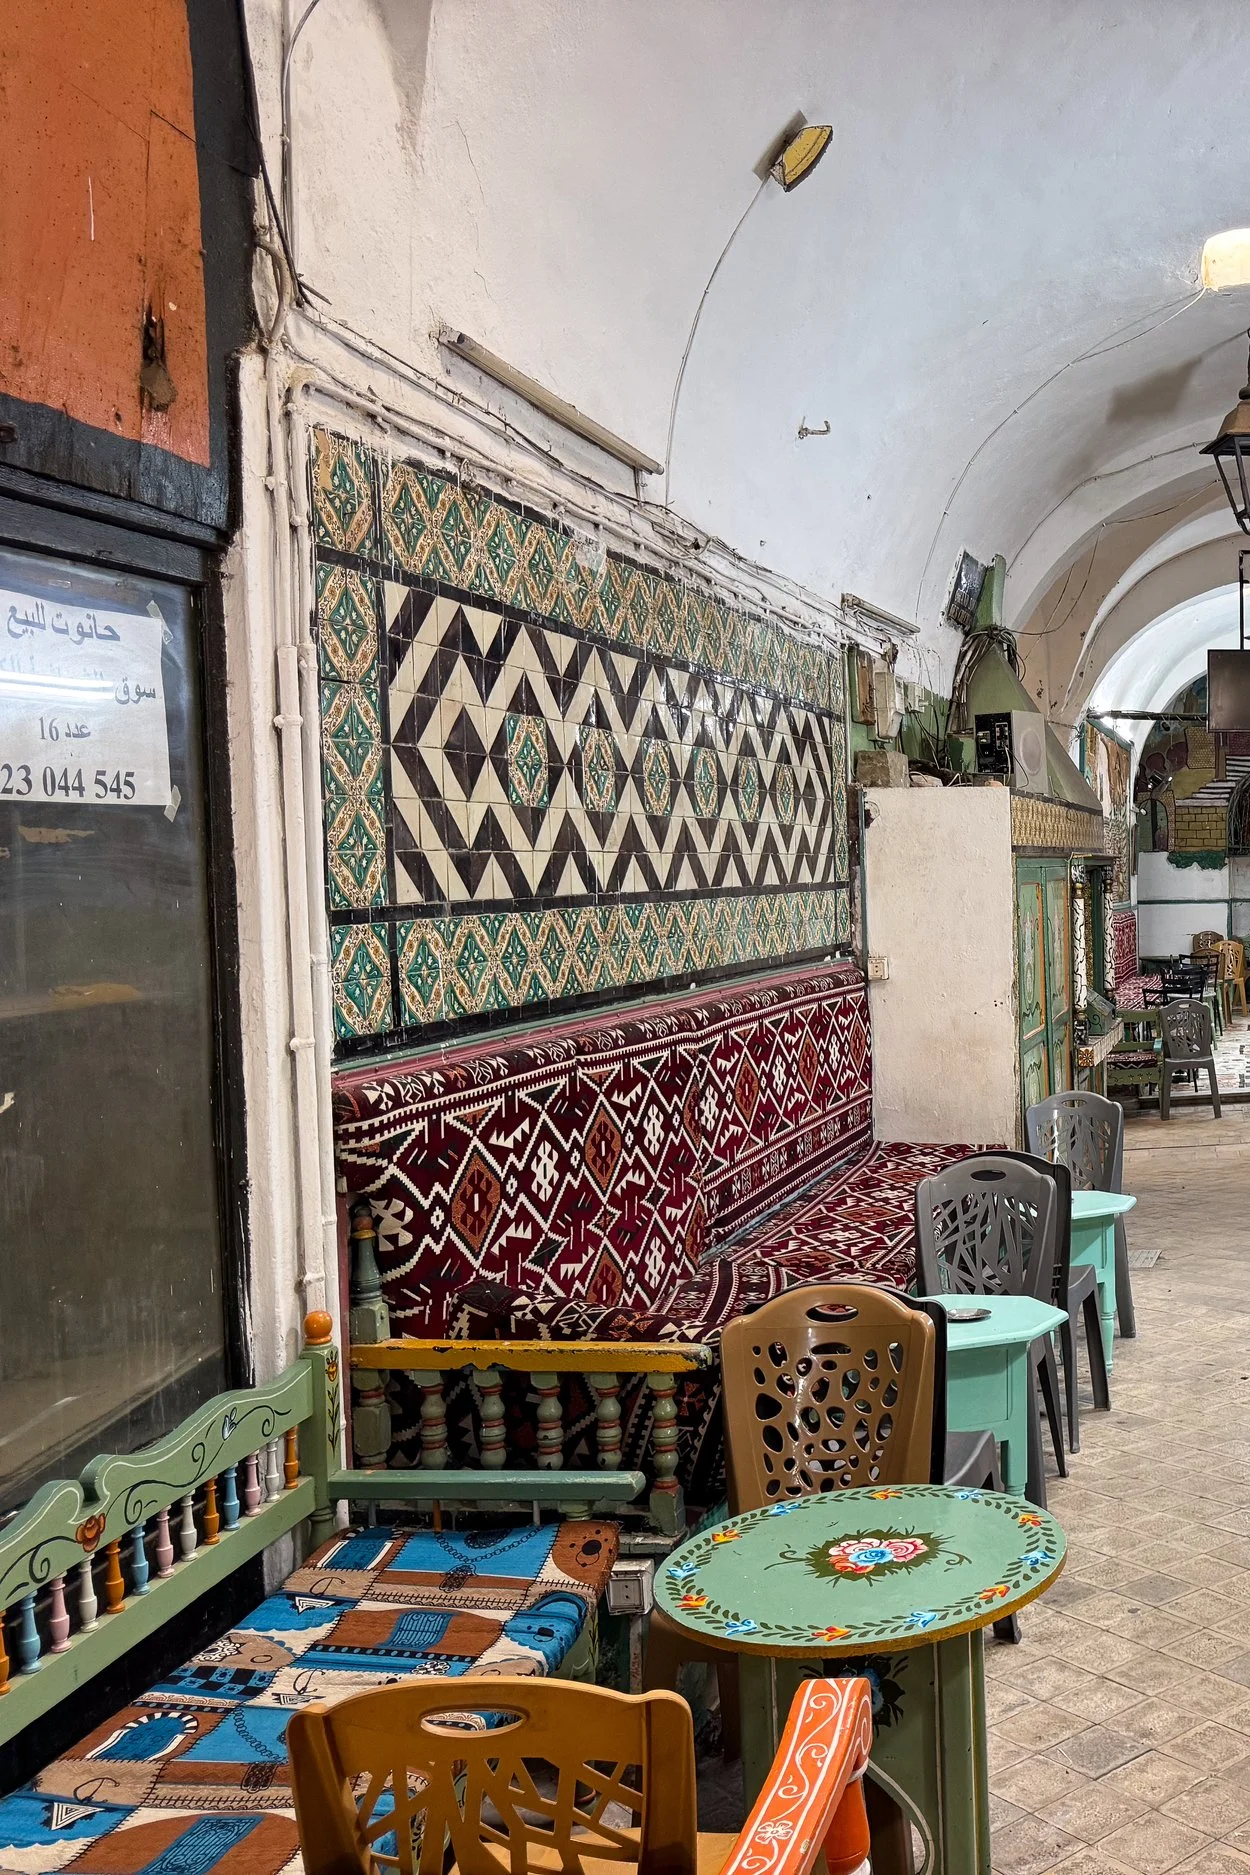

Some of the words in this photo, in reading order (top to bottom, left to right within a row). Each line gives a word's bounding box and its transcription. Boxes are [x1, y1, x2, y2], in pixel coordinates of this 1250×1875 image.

[7, 601, 46, 640] للبيع
[51, 611, 121, 646] حانوت
[114, 676, 156, 705] سوق
[39, 716, 60, 742] 16
[65, 721, 91, 739] عدد
[0, 762, 33, 796] 23
[42, 765, 86, 798] 044
[94, 769, 136, 801] 545
